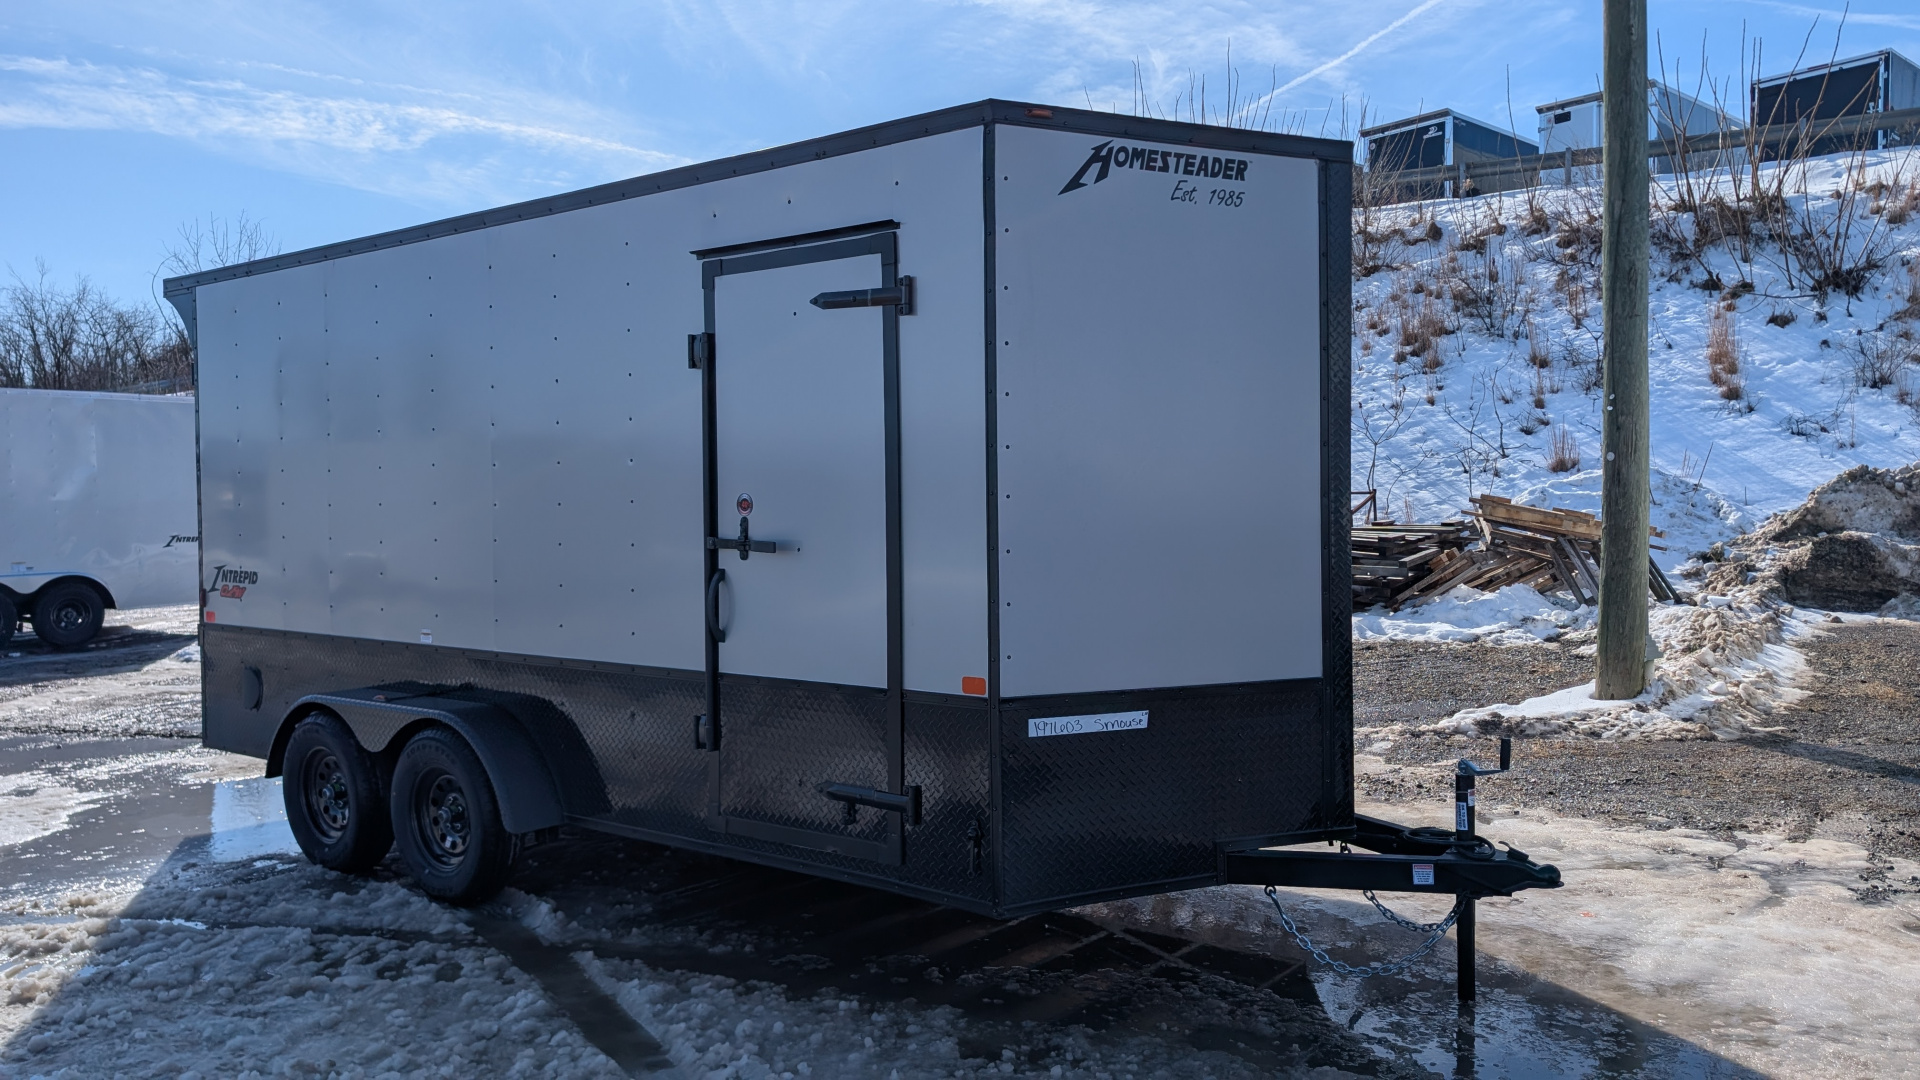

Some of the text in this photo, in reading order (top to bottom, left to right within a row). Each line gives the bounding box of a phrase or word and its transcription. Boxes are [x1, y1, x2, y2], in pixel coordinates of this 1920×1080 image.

[1058, 140, 1248, 195] HOMESTEADER
[1170, 180, 1245, 207] Est. 1985
[163, 535, 199, 548] INTREP
[207, 565, 259, 593] INTREPID
